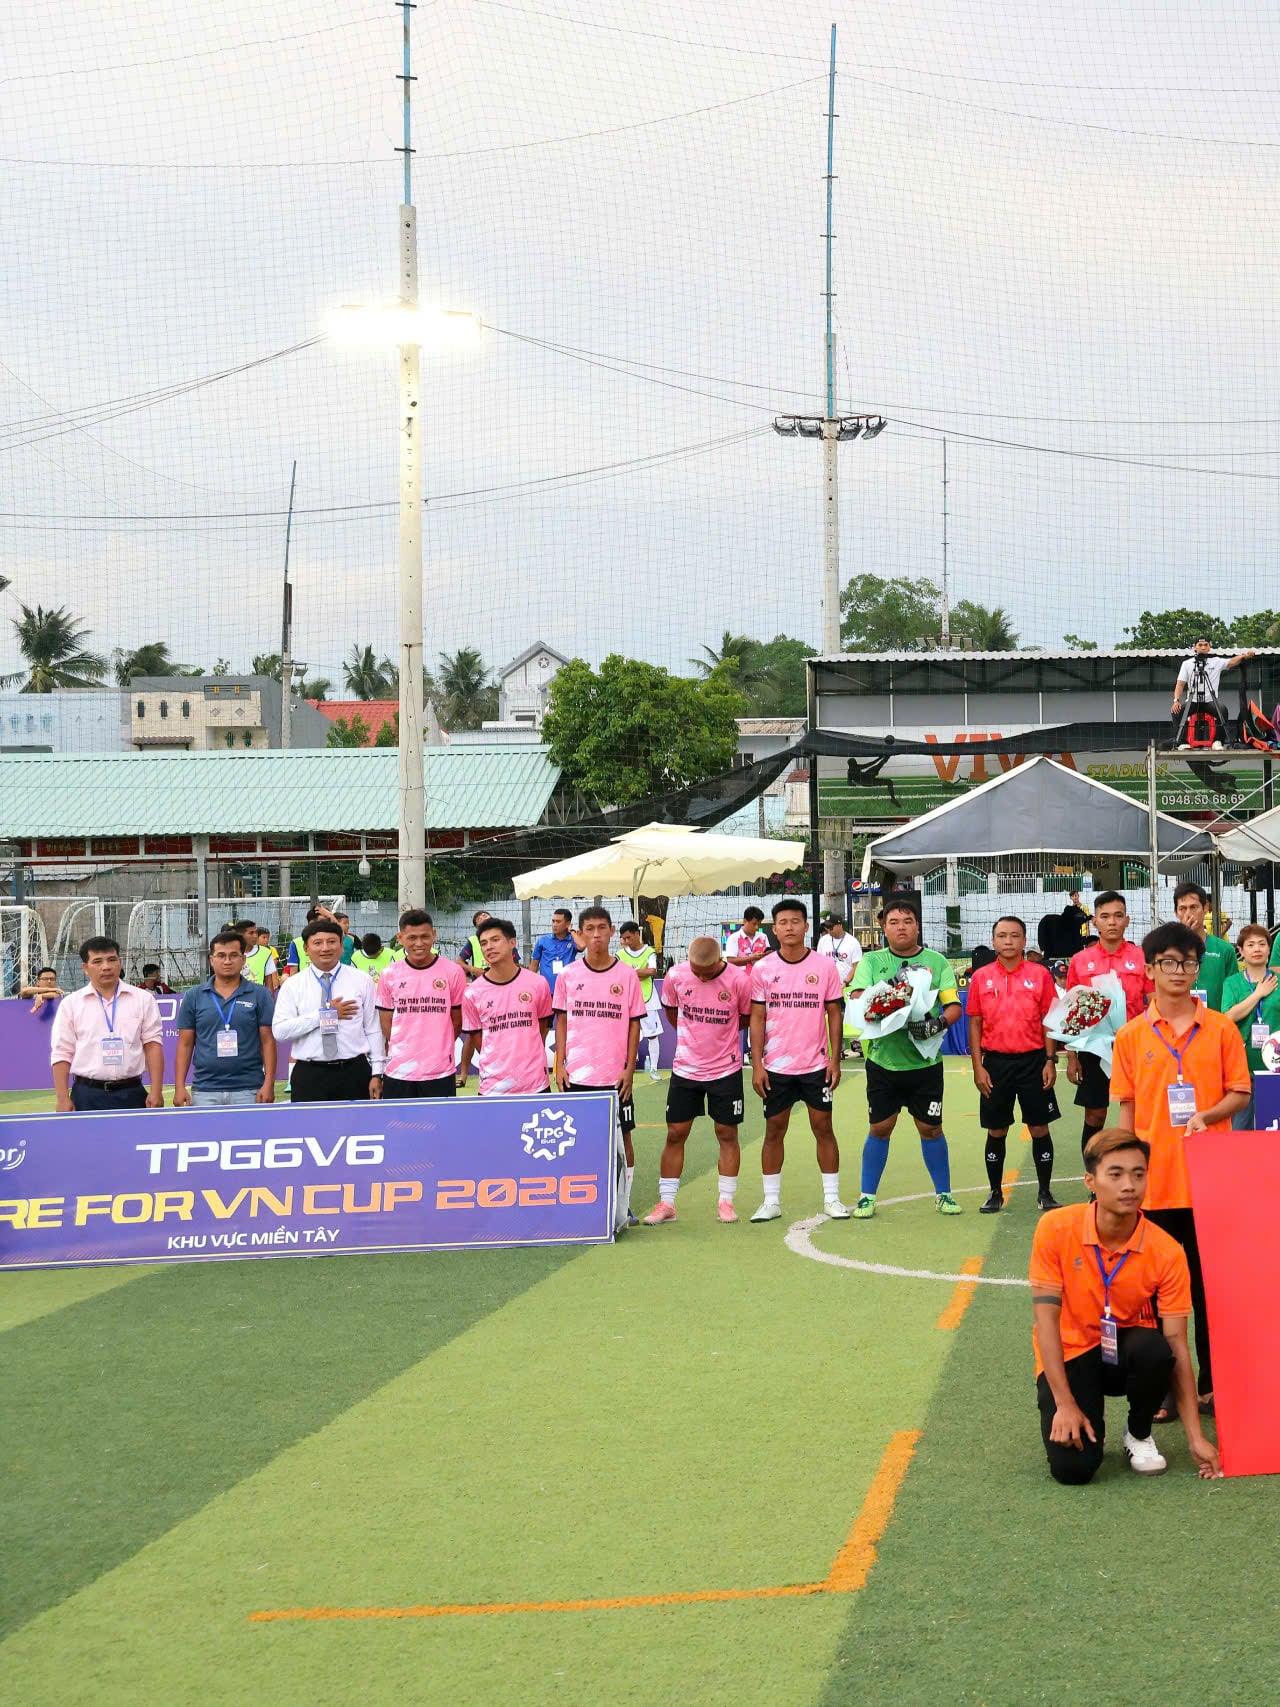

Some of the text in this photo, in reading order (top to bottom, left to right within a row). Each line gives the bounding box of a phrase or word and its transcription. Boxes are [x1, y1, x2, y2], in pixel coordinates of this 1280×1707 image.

[1087, 763, 1168, 778] STADIUM
[421, 1005, 447, 1013] GARMENT
[794, 1001, 820, 1009] GARMENT
[597, 1011, 622, 1020] GARMENT
[623, 1105, 632, 1121] 11
[533, 1127, 564, 1139] TPG
[136, 1135, 386, 1175] TPG6V6
[74, 1191, 195, 1227] FOR
[201, 1185, 294, 1220] VN
[302, 1180, 423, 1215] CUP
[435, 1174, 598, 1210] 2026
[167, 1225, 340, 1250] KHU VỰC MIỀN TÂY
